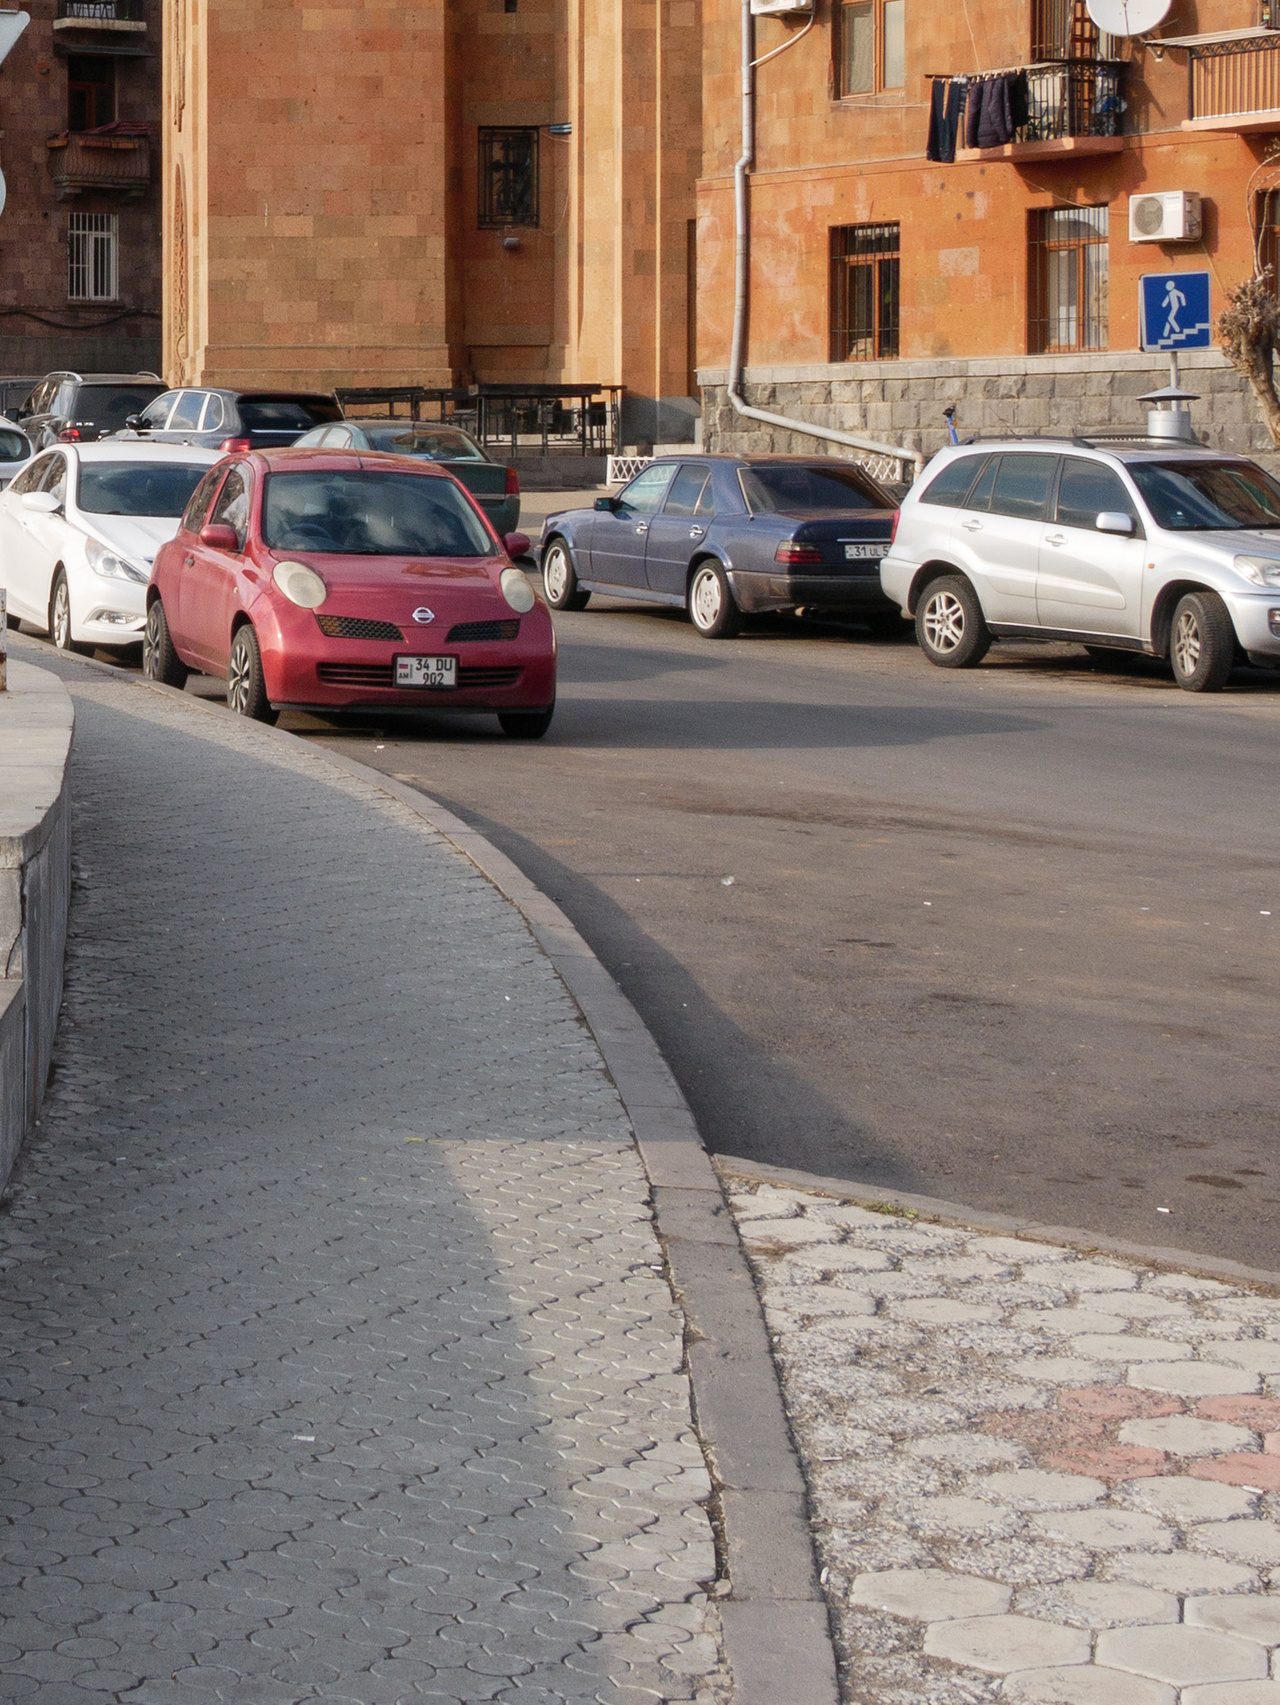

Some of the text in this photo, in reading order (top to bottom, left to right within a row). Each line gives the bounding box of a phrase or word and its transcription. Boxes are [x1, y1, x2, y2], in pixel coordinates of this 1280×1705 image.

[854, 545, 892, 557] 31 UL 5
[415, 658, 453, 672] 34 DU
[422, 672, 444, 685] 902
